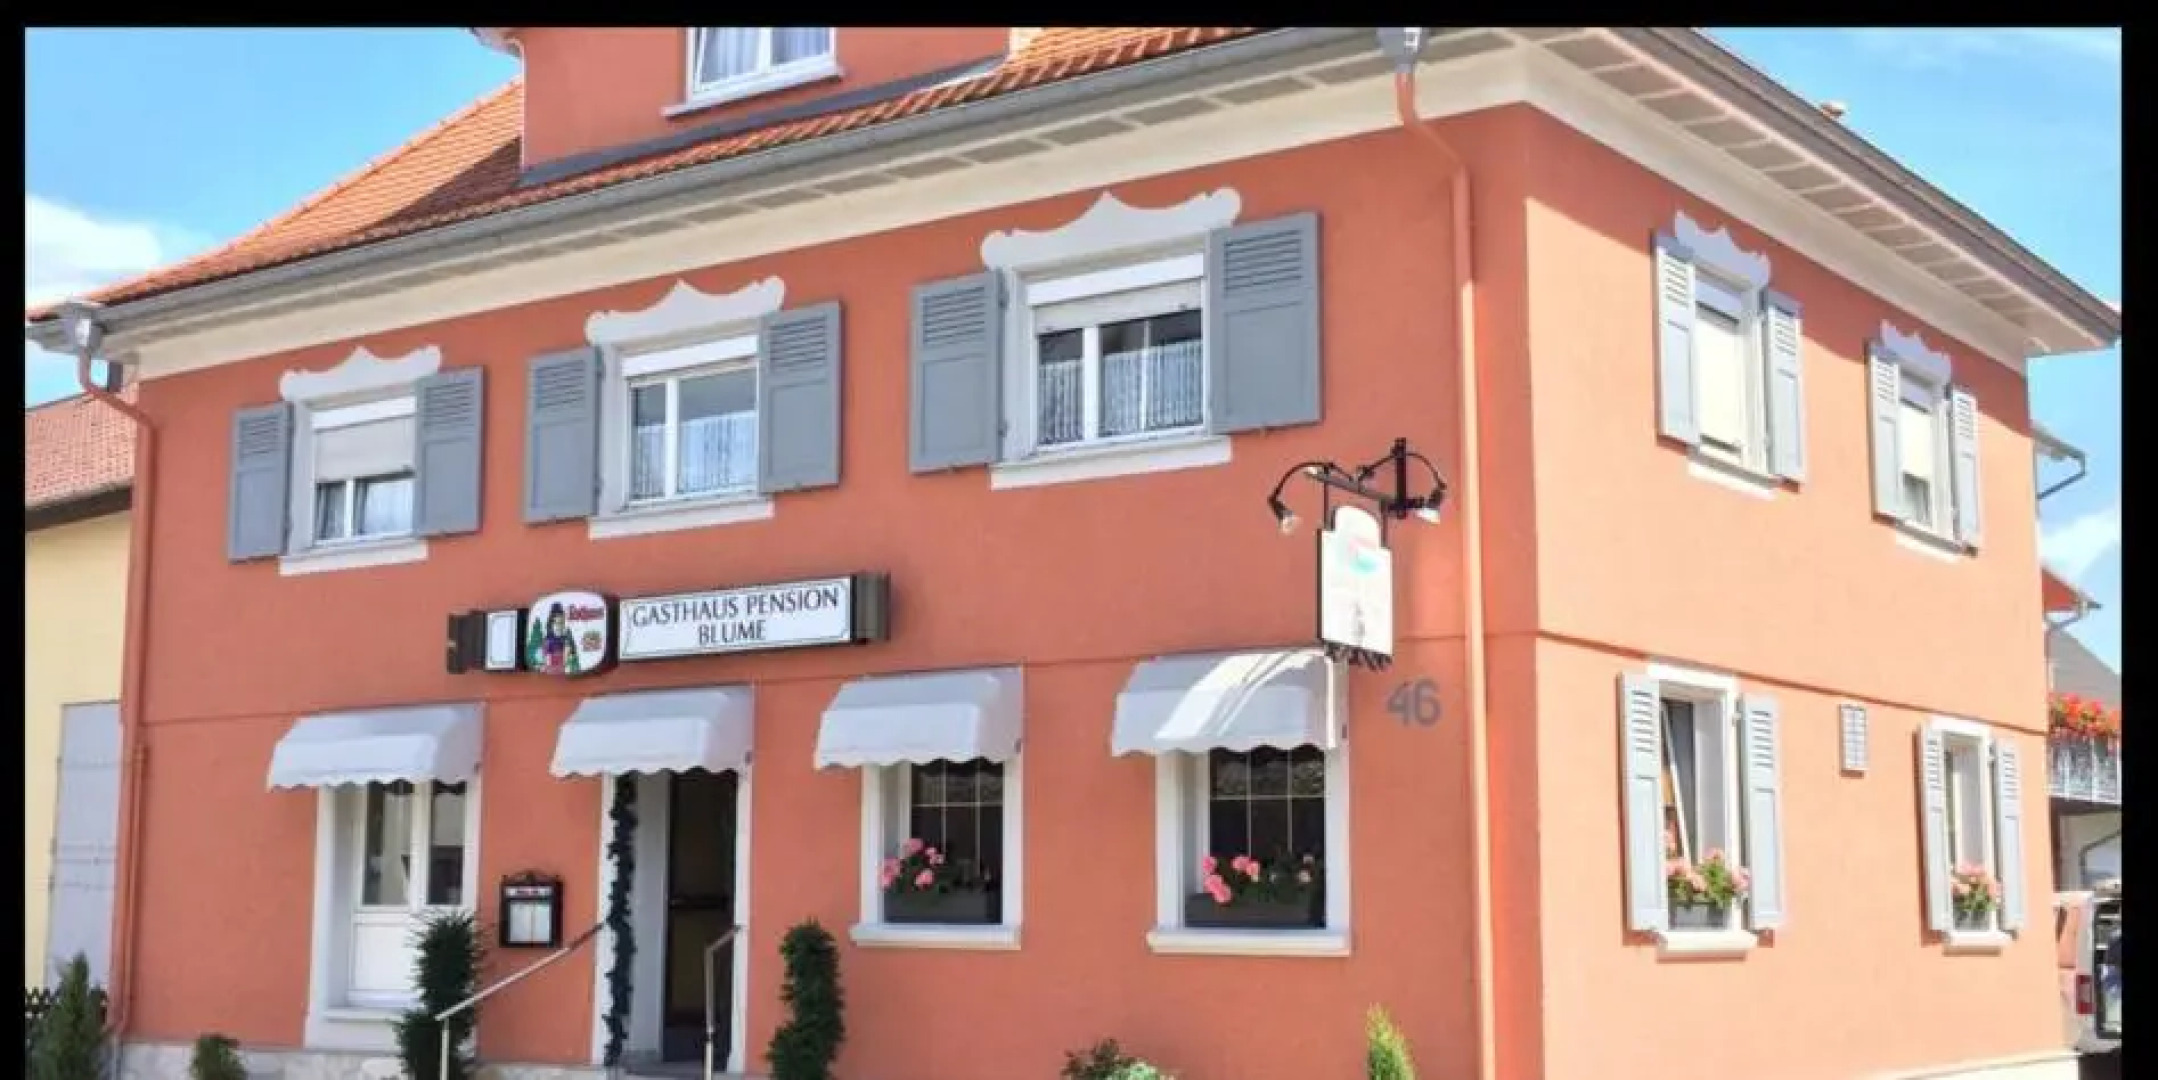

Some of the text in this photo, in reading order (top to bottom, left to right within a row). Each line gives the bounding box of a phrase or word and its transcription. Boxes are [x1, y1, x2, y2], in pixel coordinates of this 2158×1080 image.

[632, 596, 739, 627] GASTHAUS
[747, 587, 839, 616] PENSION
[699, 619, 766, 645] BLUME
[1387, 679, 1442, 727] 46
